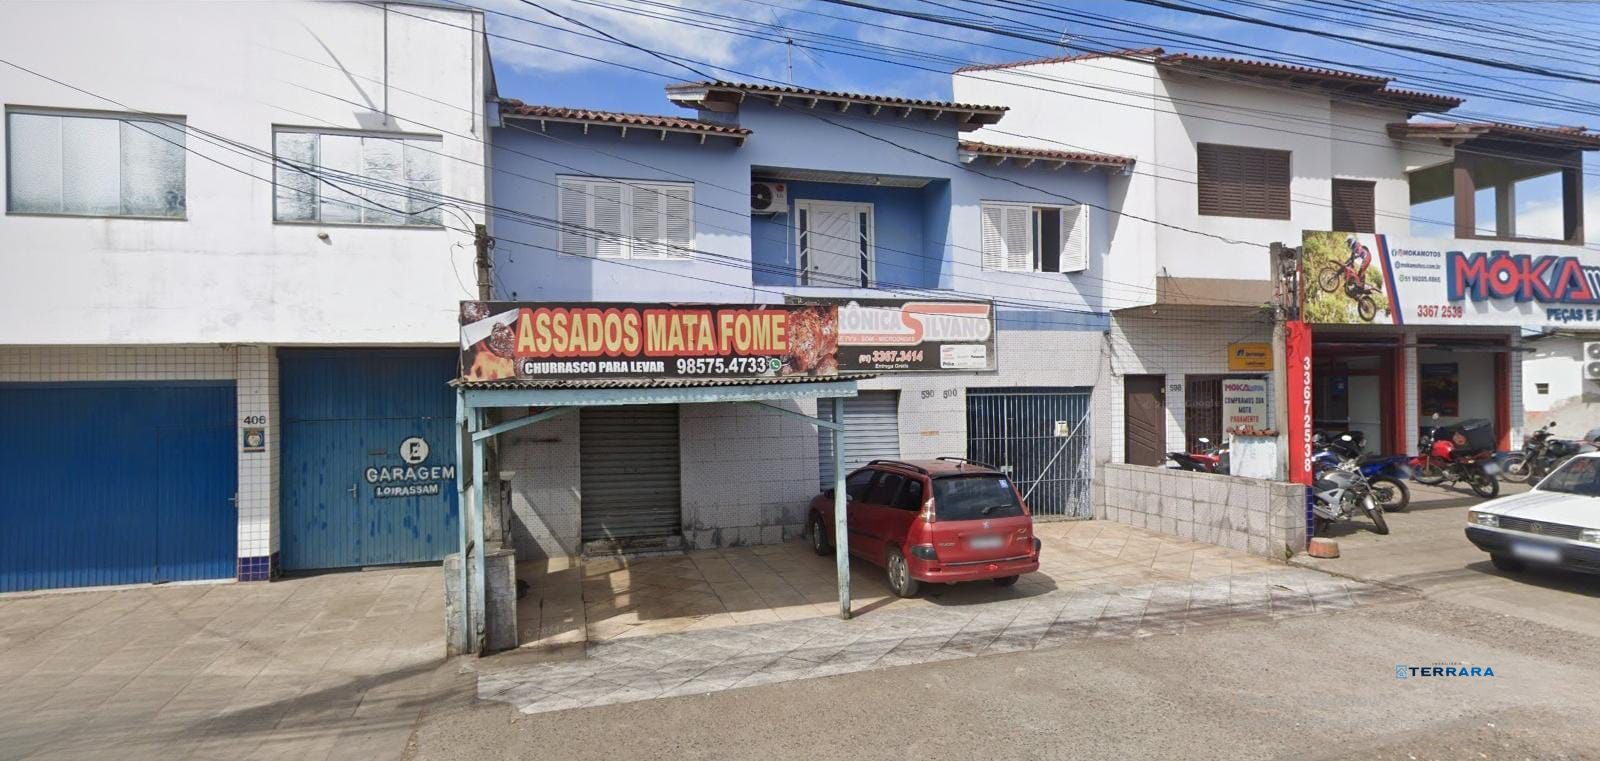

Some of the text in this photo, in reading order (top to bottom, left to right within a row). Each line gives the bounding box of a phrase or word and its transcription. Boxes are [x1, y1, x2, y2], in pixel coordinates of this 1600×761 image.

[1416, 304, 1463, 319] 3367 2538
[1547, 308, 1583, 323] PEÇAS
[1586, 309, 1594, 321] E
[517, 312, 788, 352] ASSADOS MATA FOME
[524, 357, 768, 375] CHURRASCO PARA LEVAR 98575.4733
[1303, 356, 1312, 473] 33672538
[366, 466, 455, 483] GARAGEM
